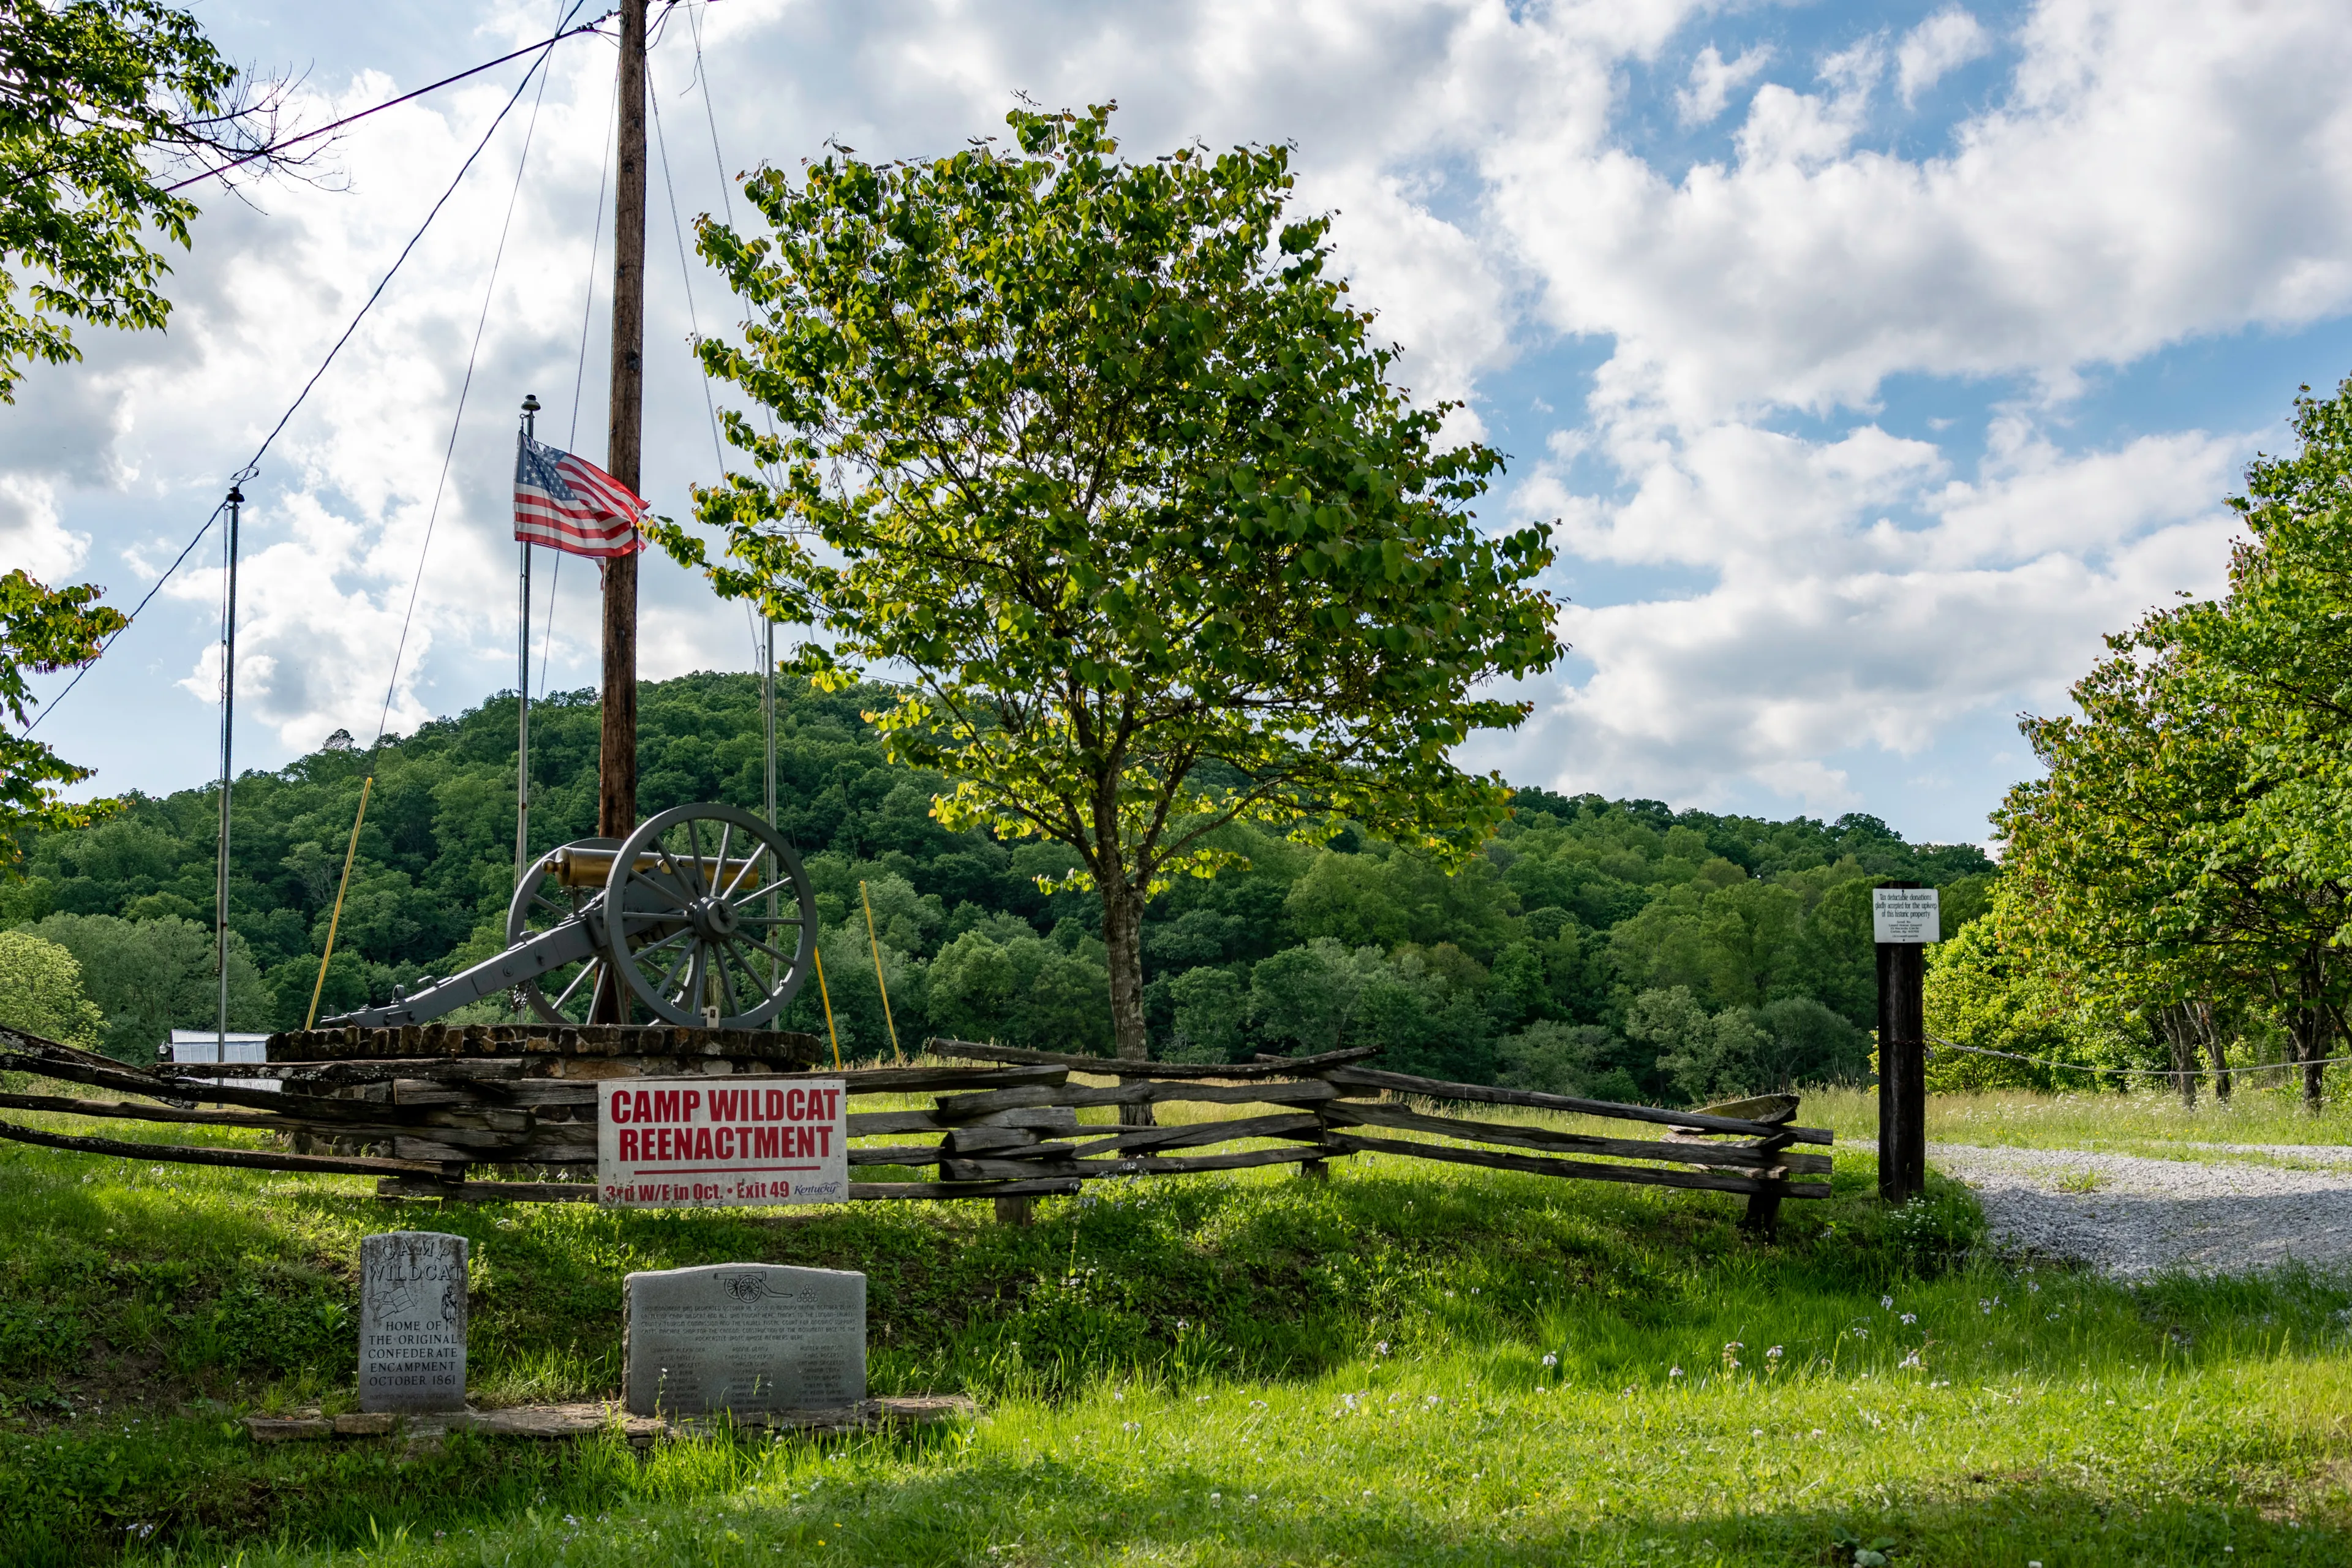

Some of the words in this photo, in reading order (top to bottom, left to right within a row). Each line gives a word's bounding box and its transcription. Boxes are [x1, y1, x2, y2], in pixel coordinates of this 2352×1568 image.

[1875, 902, 1887, 910] gladly
[611, 1090, 700, 1123] CAMP
[708, 1089, 840, 1121] WILDCAT
[619, 1126, 832, 1161] REENACTMENT
[605, 1185, 634, 1202] 3rd
[638, 1184, 669, 1201] W/E
[673, 1184, 688, 1200] in
[693, 1183, 723, 1200] Oct.
[737, 1182, 766, 1199] Exit
[770, 1181, 789, 1197] 49
[794, 1185, 836, 1196] Kentucky
[382, 1241, 451, 1260] CAMP
[368, 1265, 462, 1281] WILDCAT
[386, 1321, 420, 1331] HOME
[426, 1321, 442, 1330] OF
[369, 1335, 392, 1345] THE
[399, 1335, 457, 1344] ORIGINAL
[369, 1348, 457, 1359] CONFEDERATE
[370, 1362, 456, 1372] ENCAMPMENT
[369, 1376, 426, 1386] OCTOBER
[433, 1375, 456, 1384] 1861
